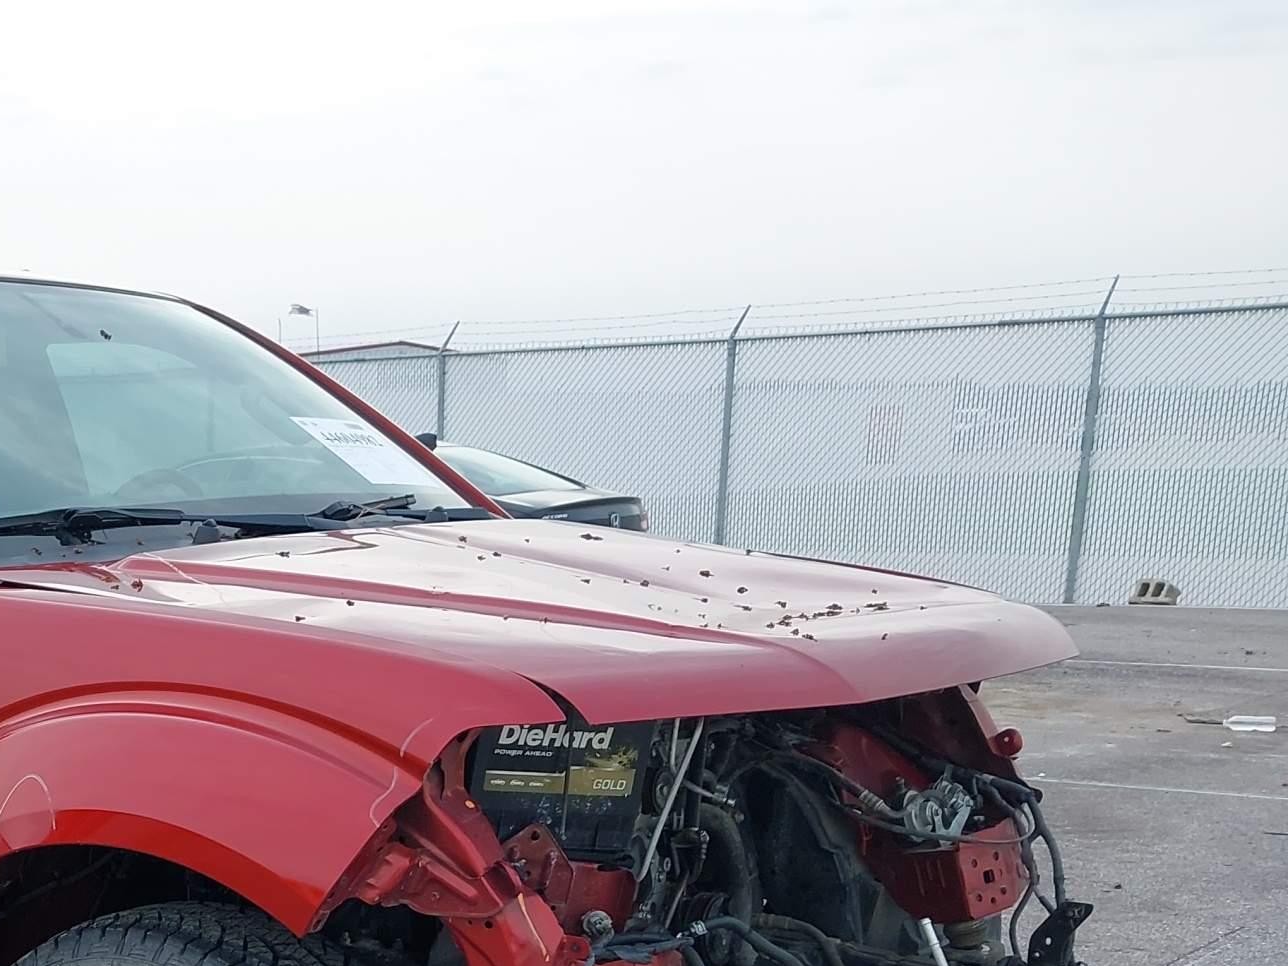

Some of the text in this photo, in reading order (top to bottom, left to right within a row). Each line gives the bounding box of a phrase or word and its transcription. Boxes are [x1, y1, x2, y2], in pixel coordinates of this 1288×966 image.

[498, 724, 614, 749] DieHard
[494, 748, 524, 757] POWER
[592, 778, 626, 791] GOLD
